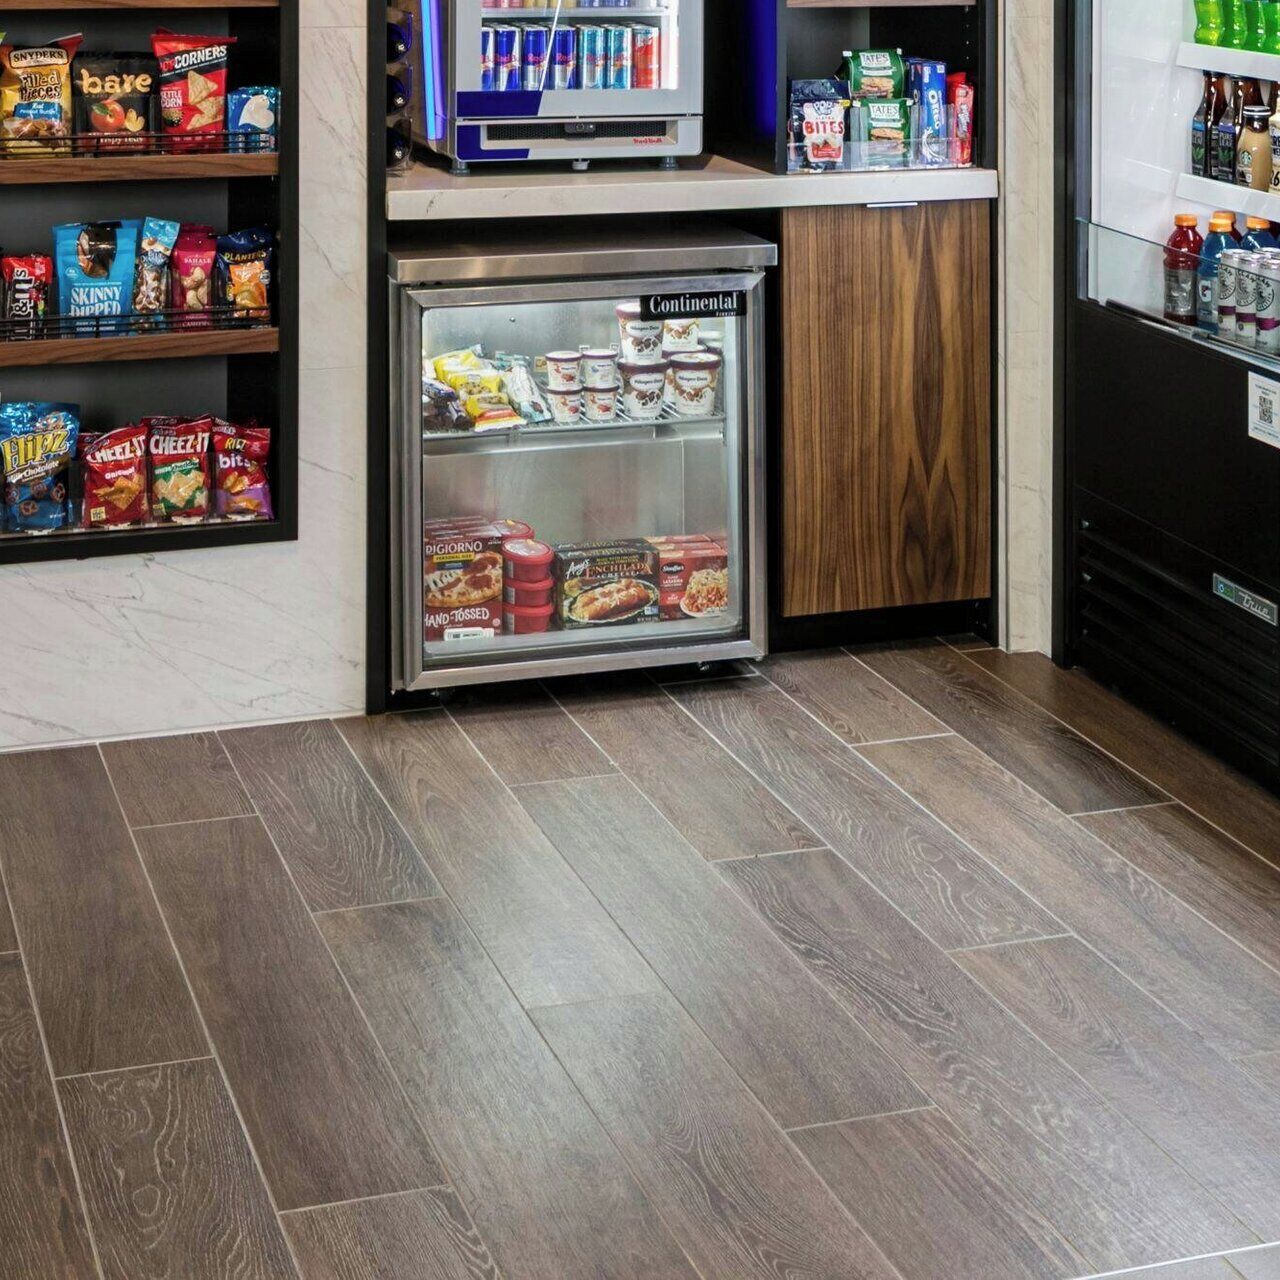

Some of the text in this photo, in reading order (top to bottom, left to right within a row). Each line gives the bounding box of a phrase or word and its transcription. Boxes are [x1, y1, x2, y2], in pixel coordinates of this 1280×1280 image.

[12, 50, 65, 63] SNYDER'S
[861, 52, 891, 64] TATE'S
[20, 72, 60, 88] Filled
[80, 66, 153, 94] bare
[18, 84, 63, 102] Pieces
[811, 100, 834, 116] POP
[870, 104, 899, 115] TATE'S
[804, 120, 844, 135] BITES
[183, 256, 212, 264] SAHALE
[223, 251, 267, 263] PLANTERS
[71, 286, 123, 303] SKINNY
[648, 291, 738, 314] Continental
[0, 430, 69, 474] Flipz
[86, 435, 147, 463] CHEEZ-IT
[149, 433, 210, 456] CHEEZ-IT
[225, 438, 247, 452] RITZ
[23, 460, 60, 478] Chocolate
[218, 453, 252, 469] bits
[425, 541, 483, 556] DIGIORNO
[565, 558, 590, 579] Amy's
[585, 562, 653, 578] ENCHILADA
[1236, 591, 1272, 620] true
